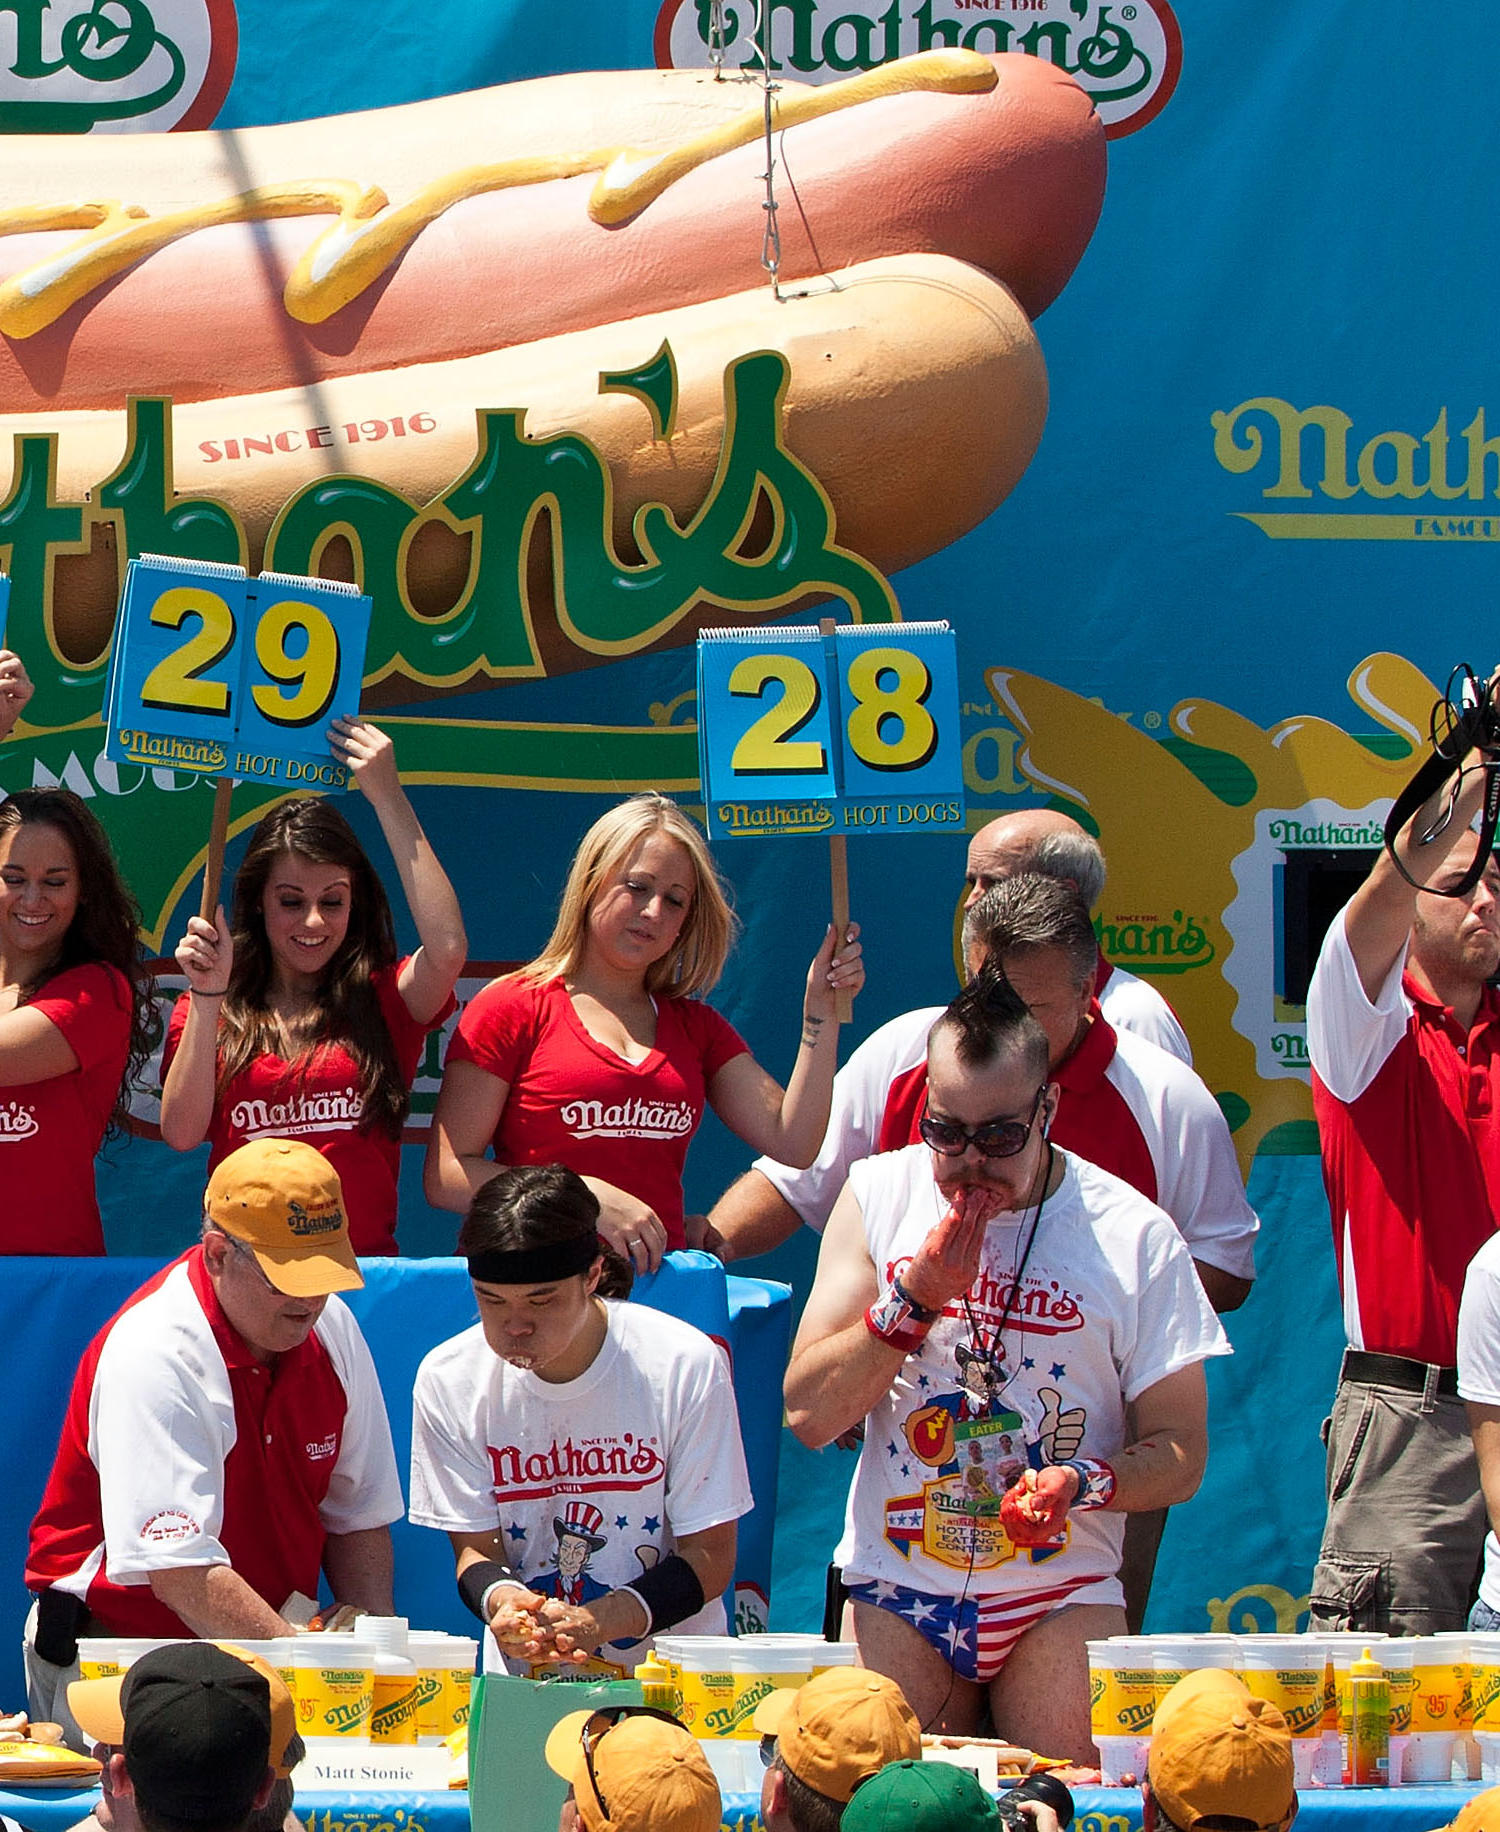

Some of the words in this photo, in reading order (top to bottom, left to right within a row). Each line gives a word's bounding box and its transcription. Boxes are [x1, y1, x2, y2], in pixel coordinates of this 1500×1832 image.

[199, 422, 334, 464] SINCE
[345, 411, 437, 443] 1916
[140, 587, 340, 727] 29
[728, 647, 940, 776] 28
[119, 728, 225, 764] Nathan's
[235, 752, 282, 776] HOT
[286, 760, 348, 787] DOGS
[718, 801, 832, 828] Nathan's
[843, 805, 893, 826] HOT
[897, 802, 962, 824] DOGS
[1268, 820, 1386, 846] Nathan's
[231, 1087, 364, 1131] Nathan's
[560, 1097, 692, 1131] Nathan's
[969, 1422, 1004, 1437] EATER
[486, 1433, 658, 1487] Nathan's
[935, 1524, 967, 1535] HOT
[969, 1528, 1004, 1538] DOG
[935, 1541, 1004, 1553] CONTEST
[300, 1698, 313, 1717] 95
[1428, 1694, 1446, 1714] 95
[315, 1765, 355, 1780] Matt
[360, 1765, 414, 1781] Stonie
